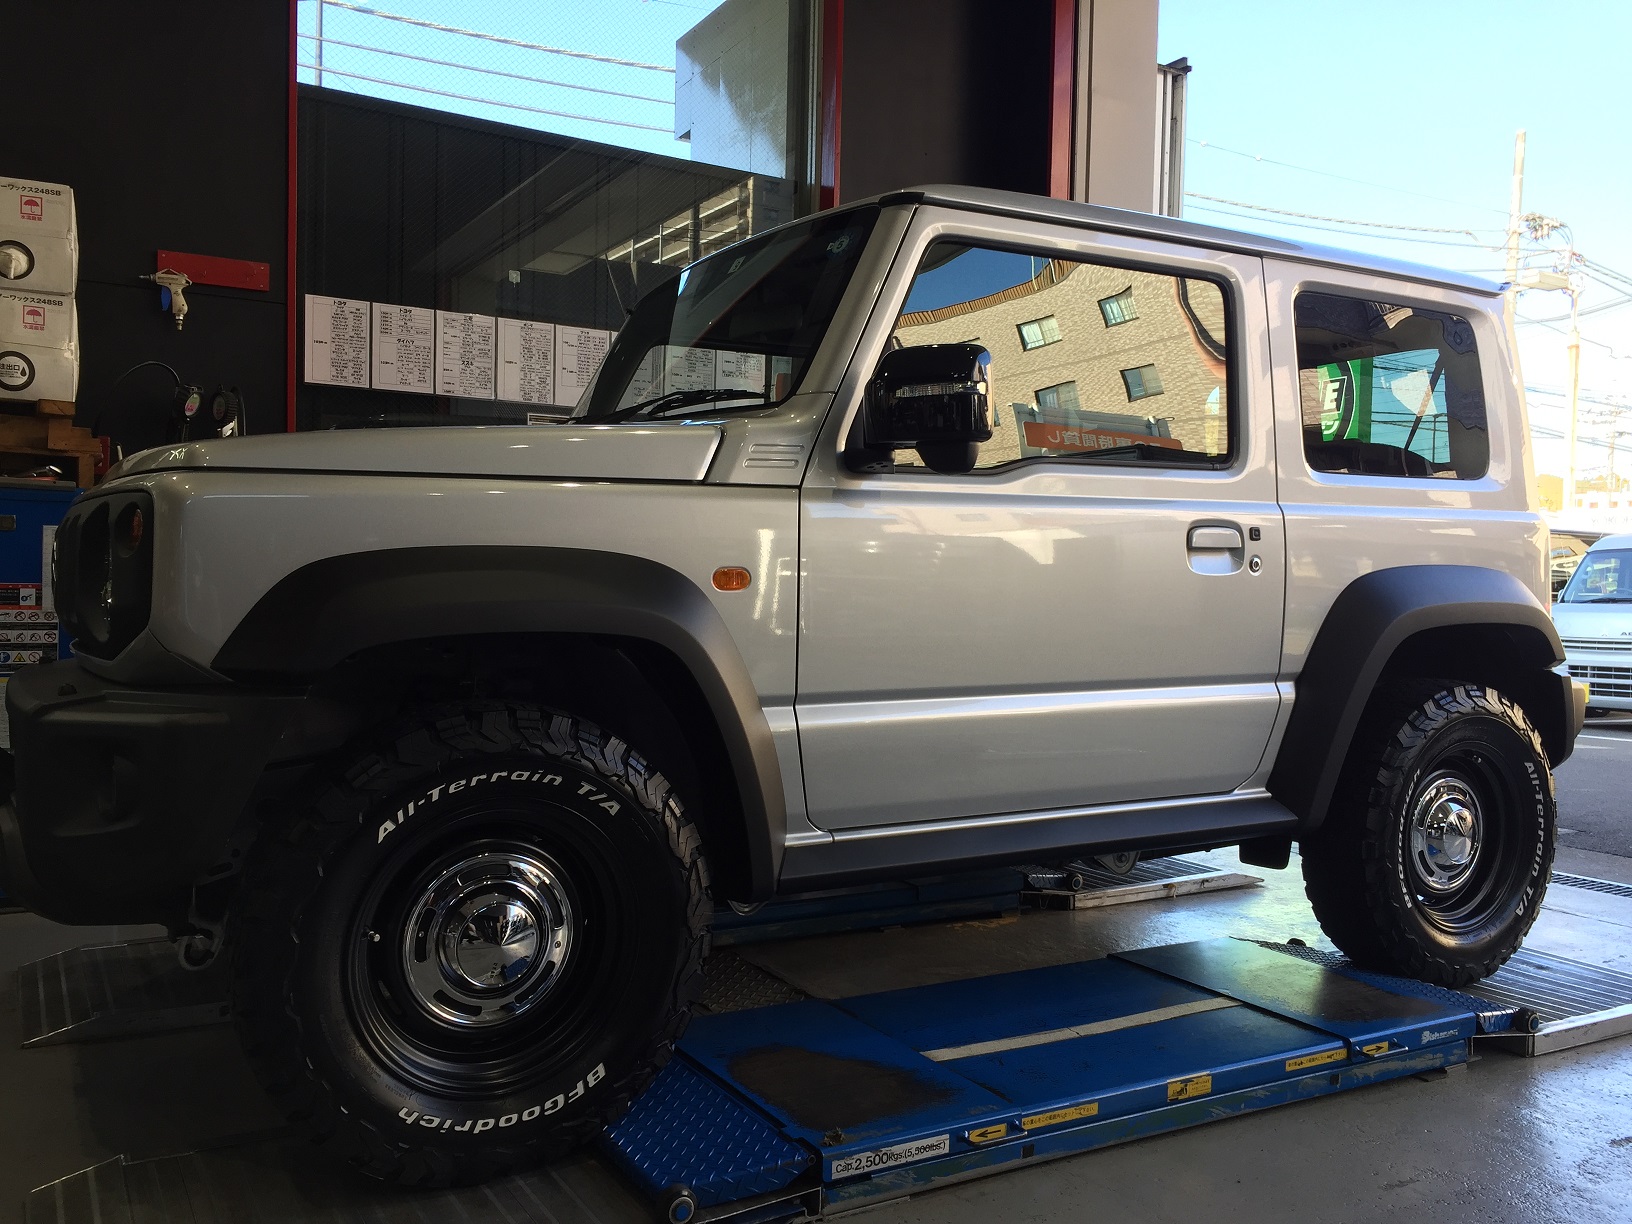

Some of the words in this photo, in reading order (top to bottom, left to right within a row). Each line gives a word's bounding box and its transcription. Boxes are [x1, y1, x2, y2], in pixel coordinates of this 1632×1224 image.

[376, 769, 565, 844] All-Terrain
[577, 780, 623, 817] T/A
[1523, 761, 1546, 878] All-Terrain
[1514, 885, 1535, 917] T/A
[396, 1060, 607, 1136] BFGoodrich
